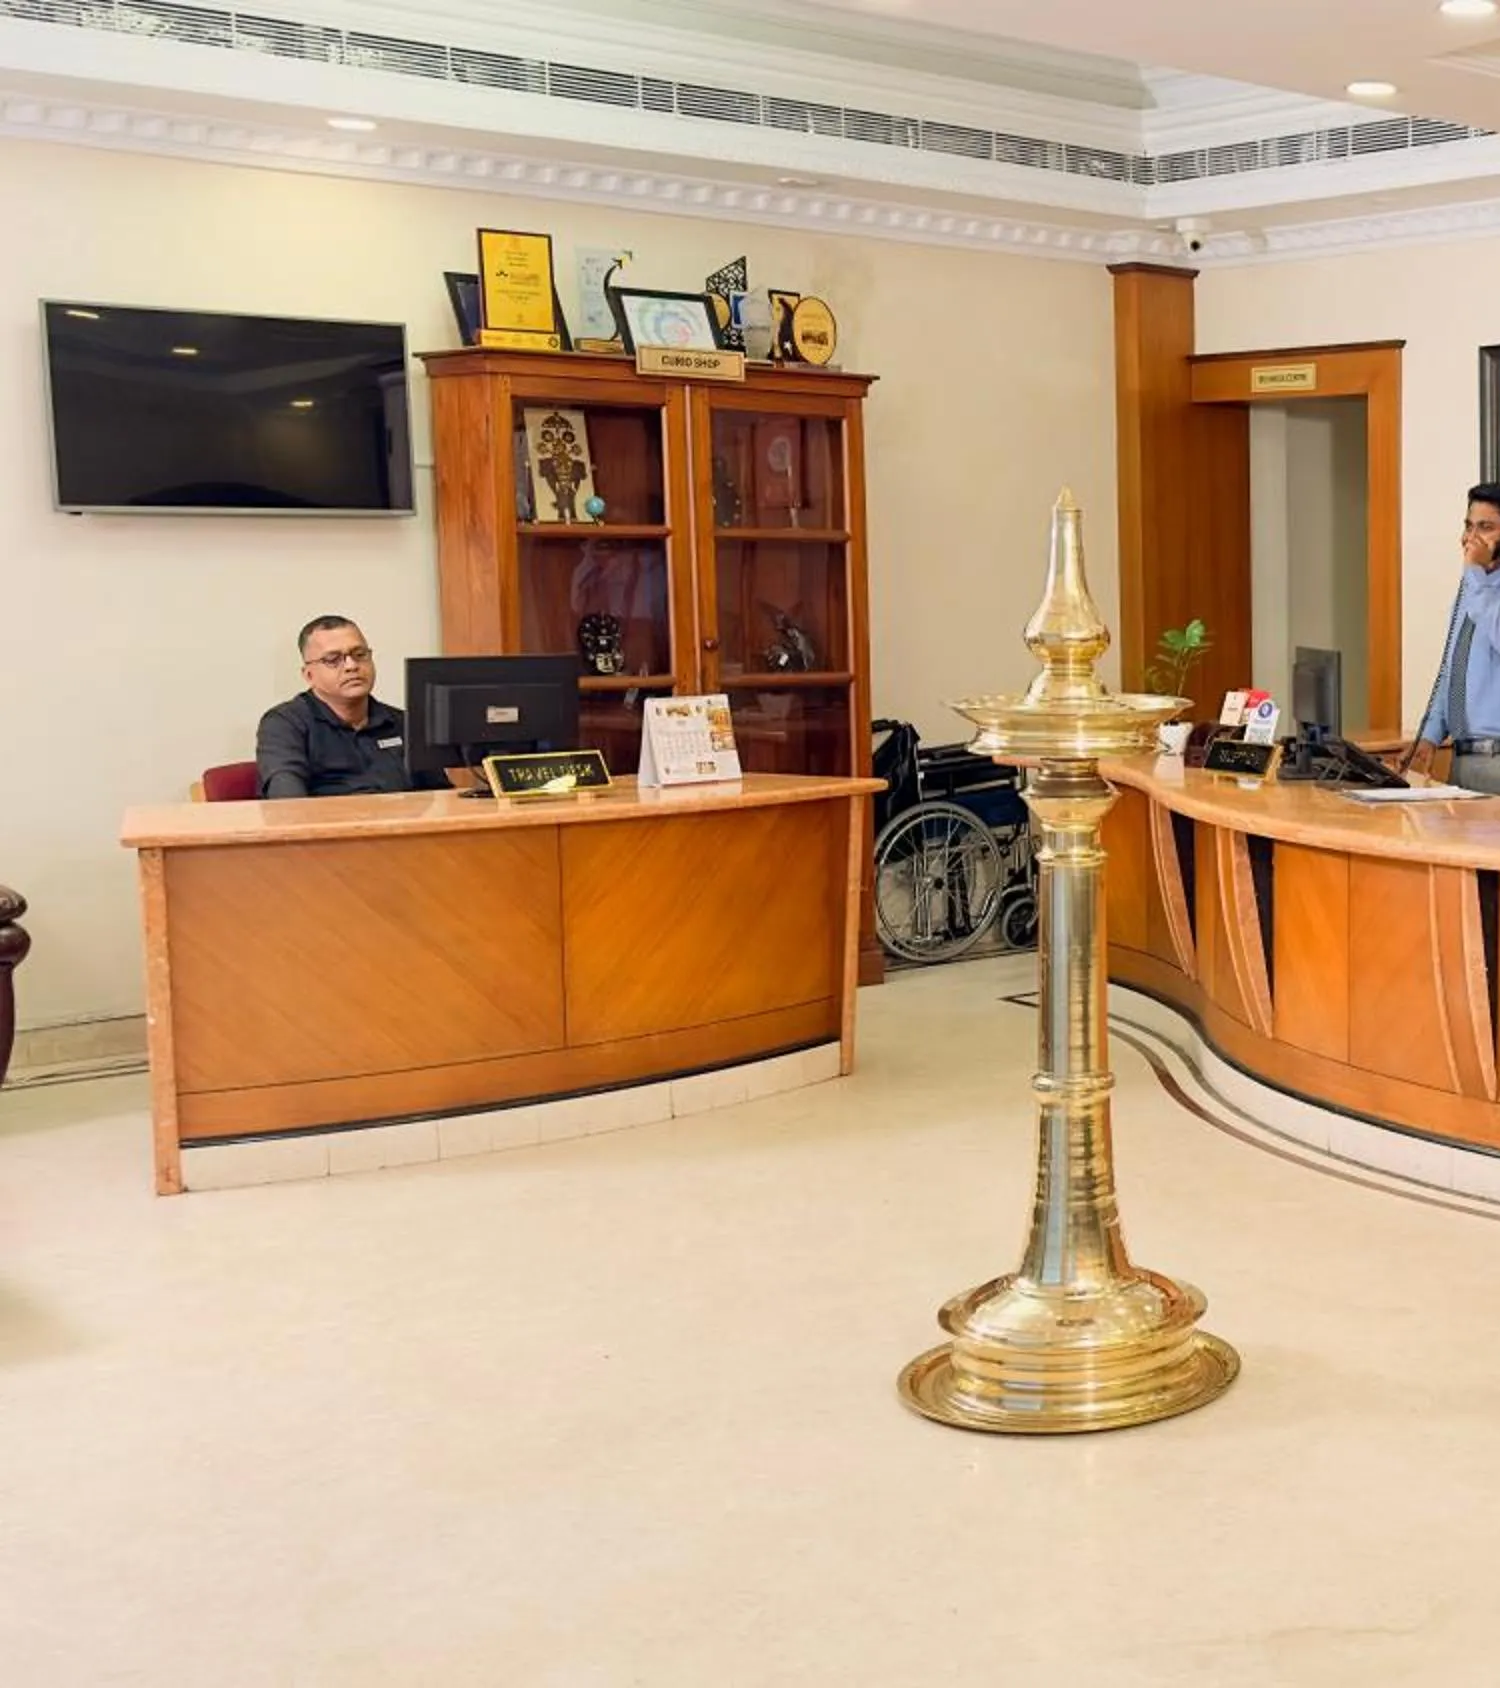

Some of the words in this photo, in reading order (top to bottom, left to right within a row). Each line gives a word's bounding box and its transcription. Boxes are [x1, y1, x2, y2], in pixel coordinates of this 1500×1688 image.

[661, 355, 693, 369] CURIO
[694, 357, 721, 369] SHOP
[507, 766, 556, 782] TRAVEL
[559, 763, 594, 778] DESK
